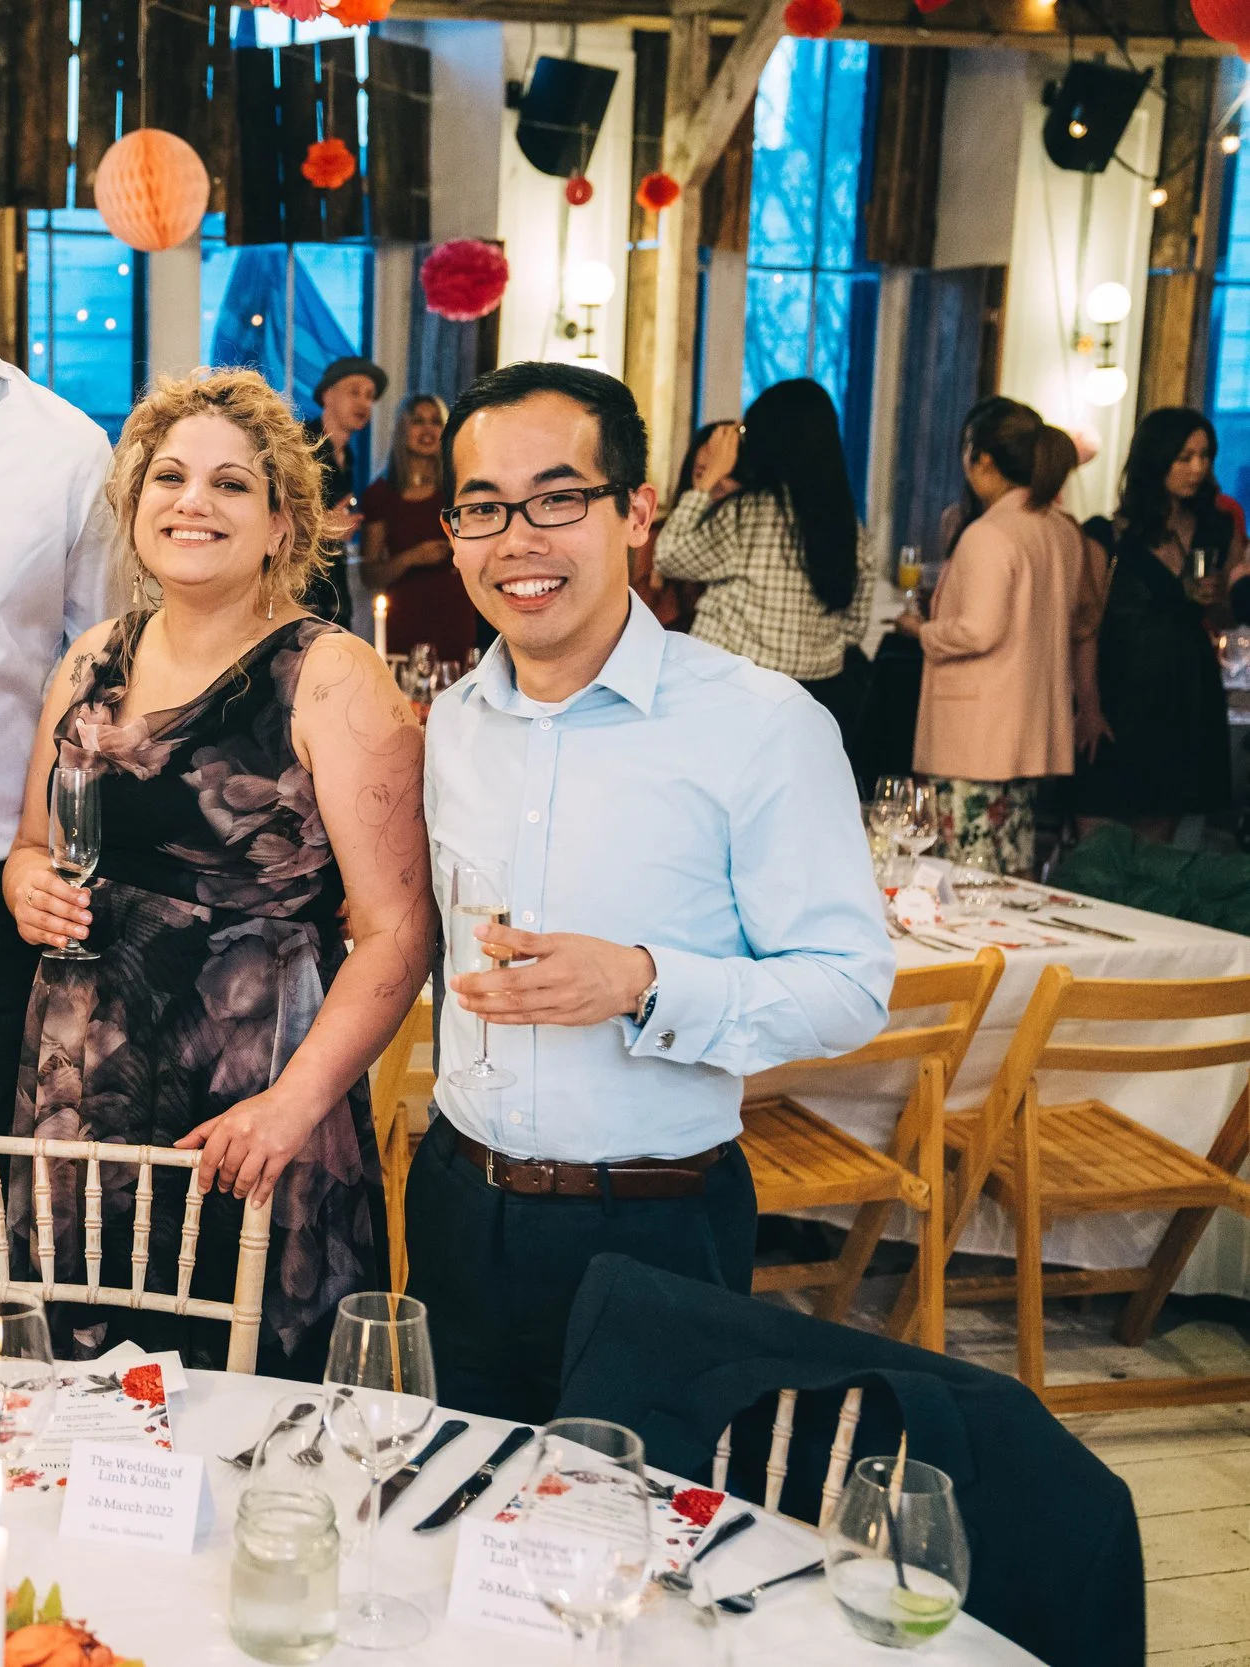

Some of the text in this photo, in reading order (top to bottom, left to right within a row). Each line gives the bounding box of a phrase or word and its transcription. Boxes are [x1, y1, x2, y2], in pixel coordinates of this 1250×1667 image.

[90, 1454, 184, 1479] The Wedding of
[98, 1468, 172, 1491] Linh & John
[87, 1494, 174, 1518] 26 March 2022
[481, 1533, 507, 1550] The
[477, 1577, 494, 1592] 26
